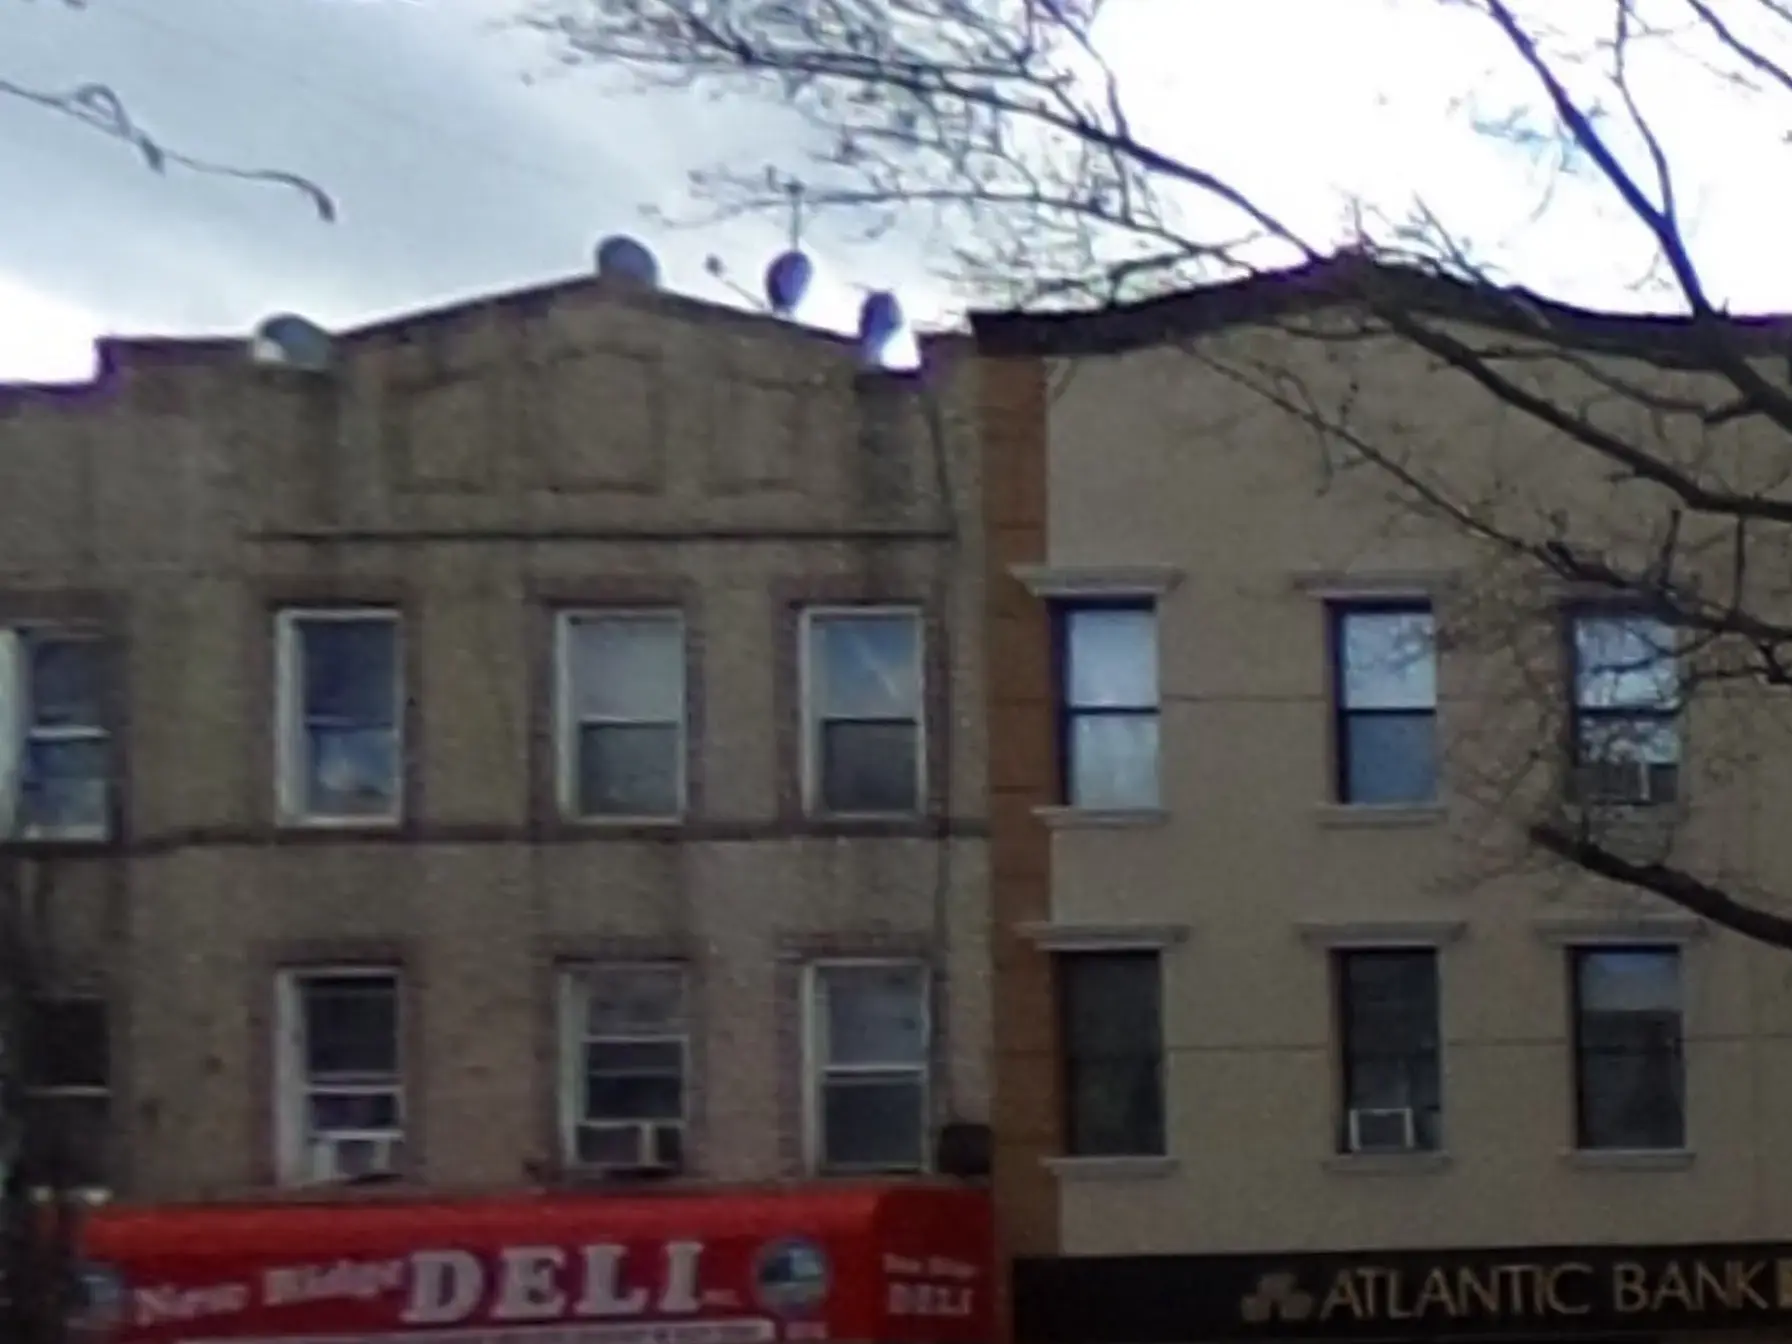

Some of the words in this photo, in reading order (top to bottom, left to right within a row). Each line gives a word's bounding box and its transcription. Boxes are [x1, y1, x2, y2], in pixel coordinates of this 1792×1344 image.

[401, 1241, 705, 1323] DELI
[888, 1282, 974, 1316] DELI
[1320, 1263, 1593, 1321] ATLANTIC
[1613, 1259, 1769, 1314] BANK
